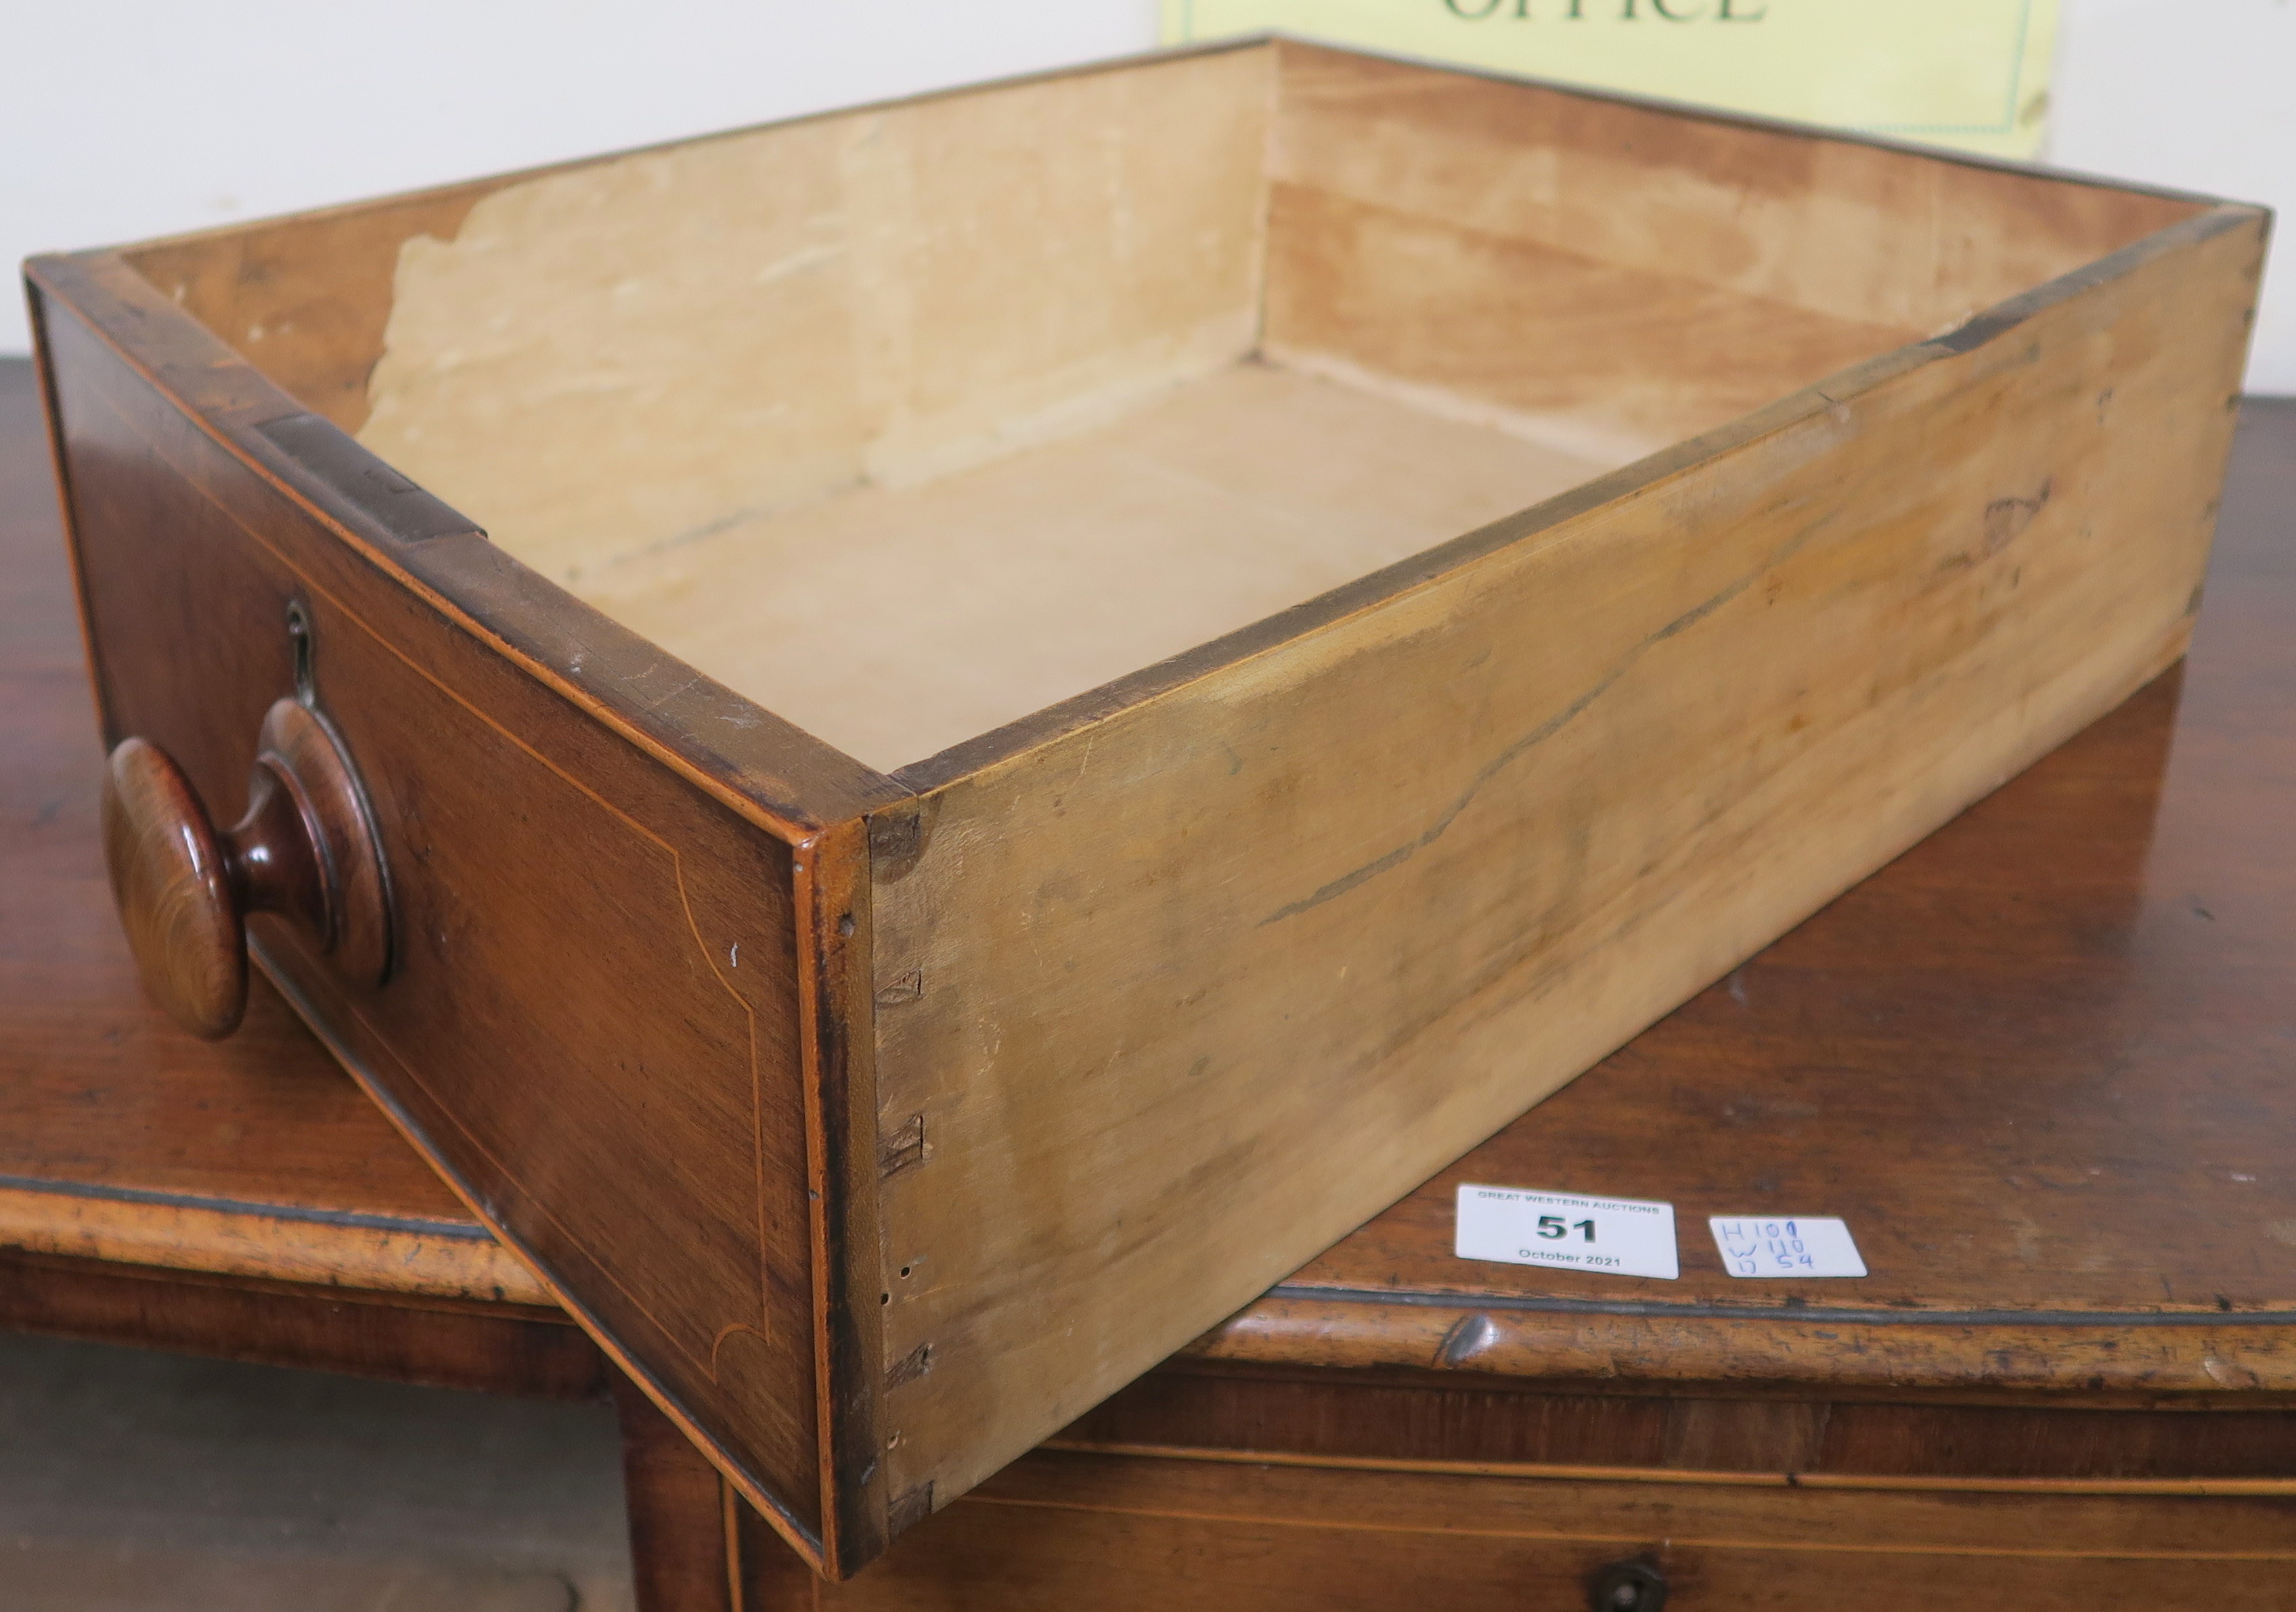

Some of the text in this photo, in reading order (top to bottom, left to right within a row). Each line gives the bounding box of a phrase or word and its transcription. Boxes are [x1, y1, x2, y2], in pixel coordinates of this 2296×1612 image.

[1478, 1191, 1660, 1215] GREAT WESTERN AUCTIONS
[1537, 1216, 1597, 1243] 51
[1519, 1249, 1620, 1267] October 2021
[1729, 1245, 1757, 1258] W
[1776, 1255, 1815, 1269] 54
